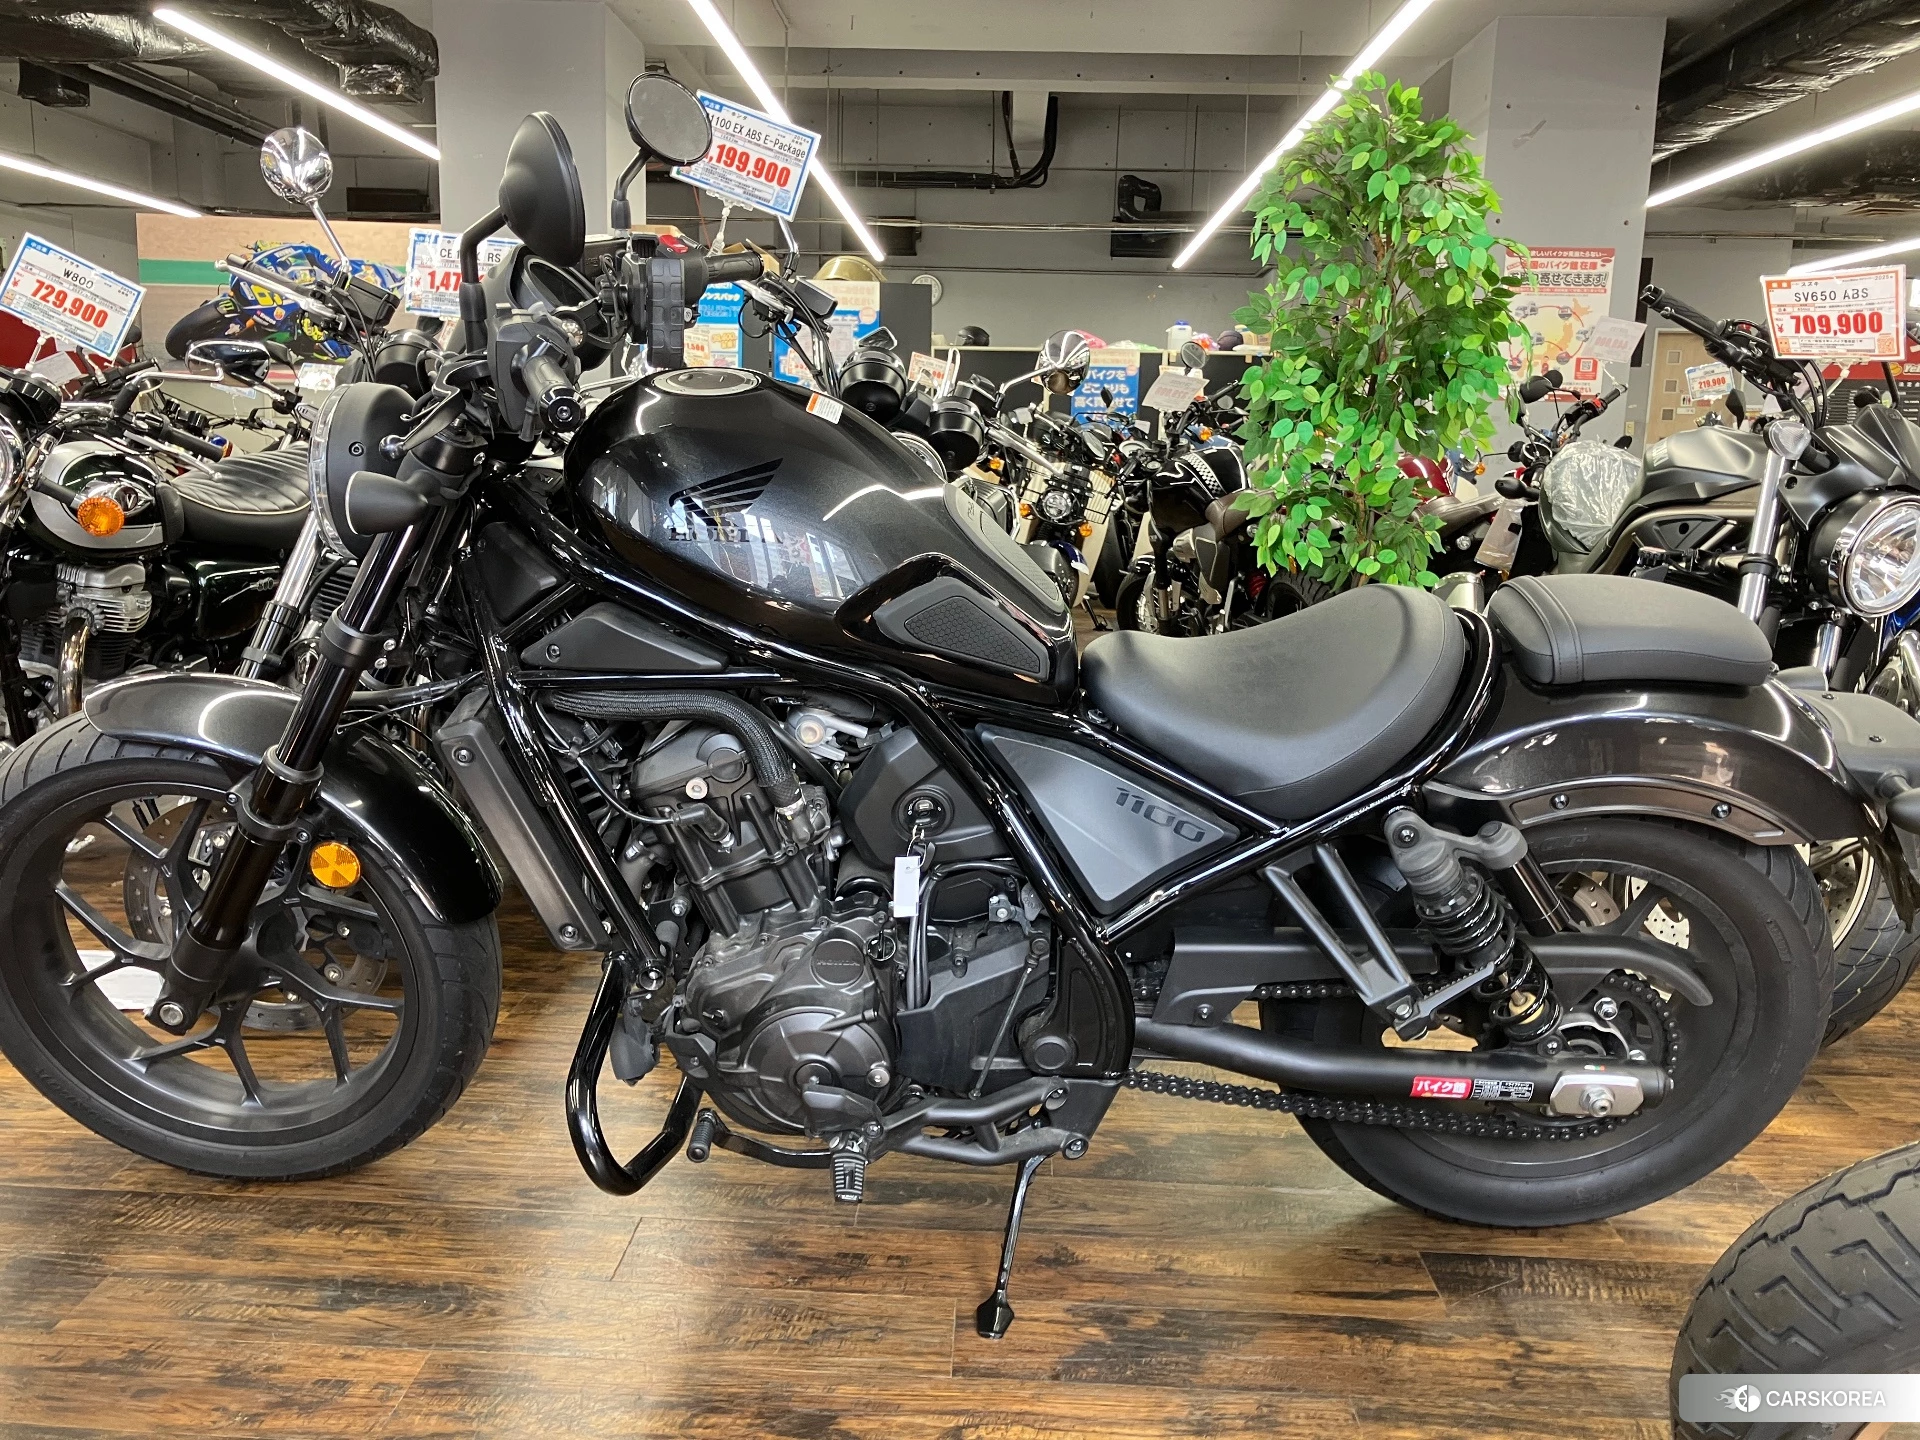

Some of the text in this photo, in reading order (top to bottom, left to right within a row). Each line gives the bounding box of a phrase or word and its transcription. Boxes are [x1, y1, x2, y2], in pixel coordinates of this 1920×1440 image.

[708, 113, 806, 159] 1100 EX ABS E-Package
[63, 267, 94, 289] W800
[1794, 288, 1869, 302] SV650 ABS
[30, 279, 109, 328] 729,900
[1789, 311, 1883, 336] 709,900
[1116, 786, 1206, 843] 1100
